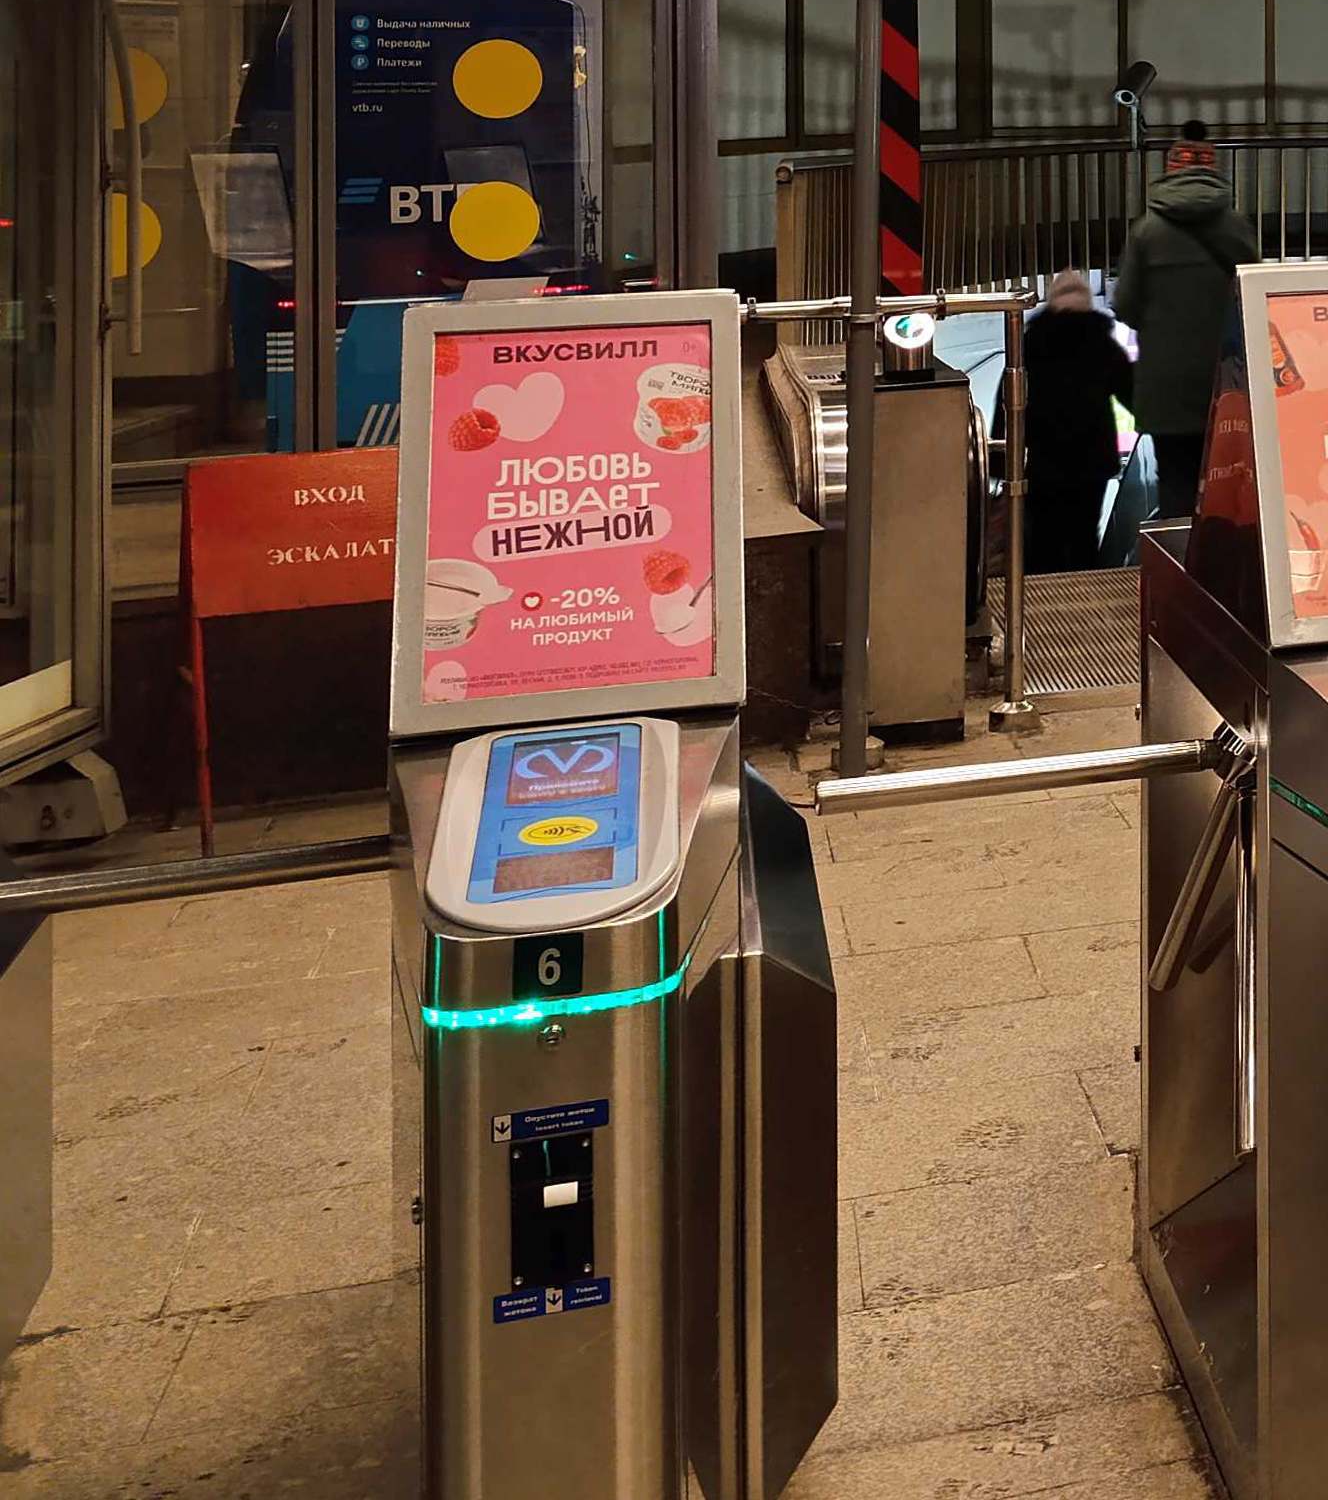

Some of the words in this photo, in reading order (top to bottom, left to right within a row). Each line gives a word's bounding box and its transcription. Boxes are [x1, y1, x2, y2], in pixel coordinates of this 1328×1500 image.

[377, 18, 417, 30] Выдача
[419, 19, 471, 29] наличных
[377, 37, 431, 49] Переводы
[377, 57, 422, 68] Платежи
[352, 102, 383, 113] vtb.ru
[389, 182, 482, 225] ВТ
[493, 340, 658, 364] ВКУСВИЛЛ
[497, 451, 652, 487] ЛЮБОВЬ
[294, 484, 366, 506] ВХОД
[491, 507, 655, 557] НЕЖНОЙ
[550, 586, 620, 610] -20%
[510, 615, 536, 631] НА
[536, 606, 634, 629] ЛЮБИМЫЙ
[532, 628, 614, 648] ПРОДУКТ
[537, 947, 561, 986] 6
